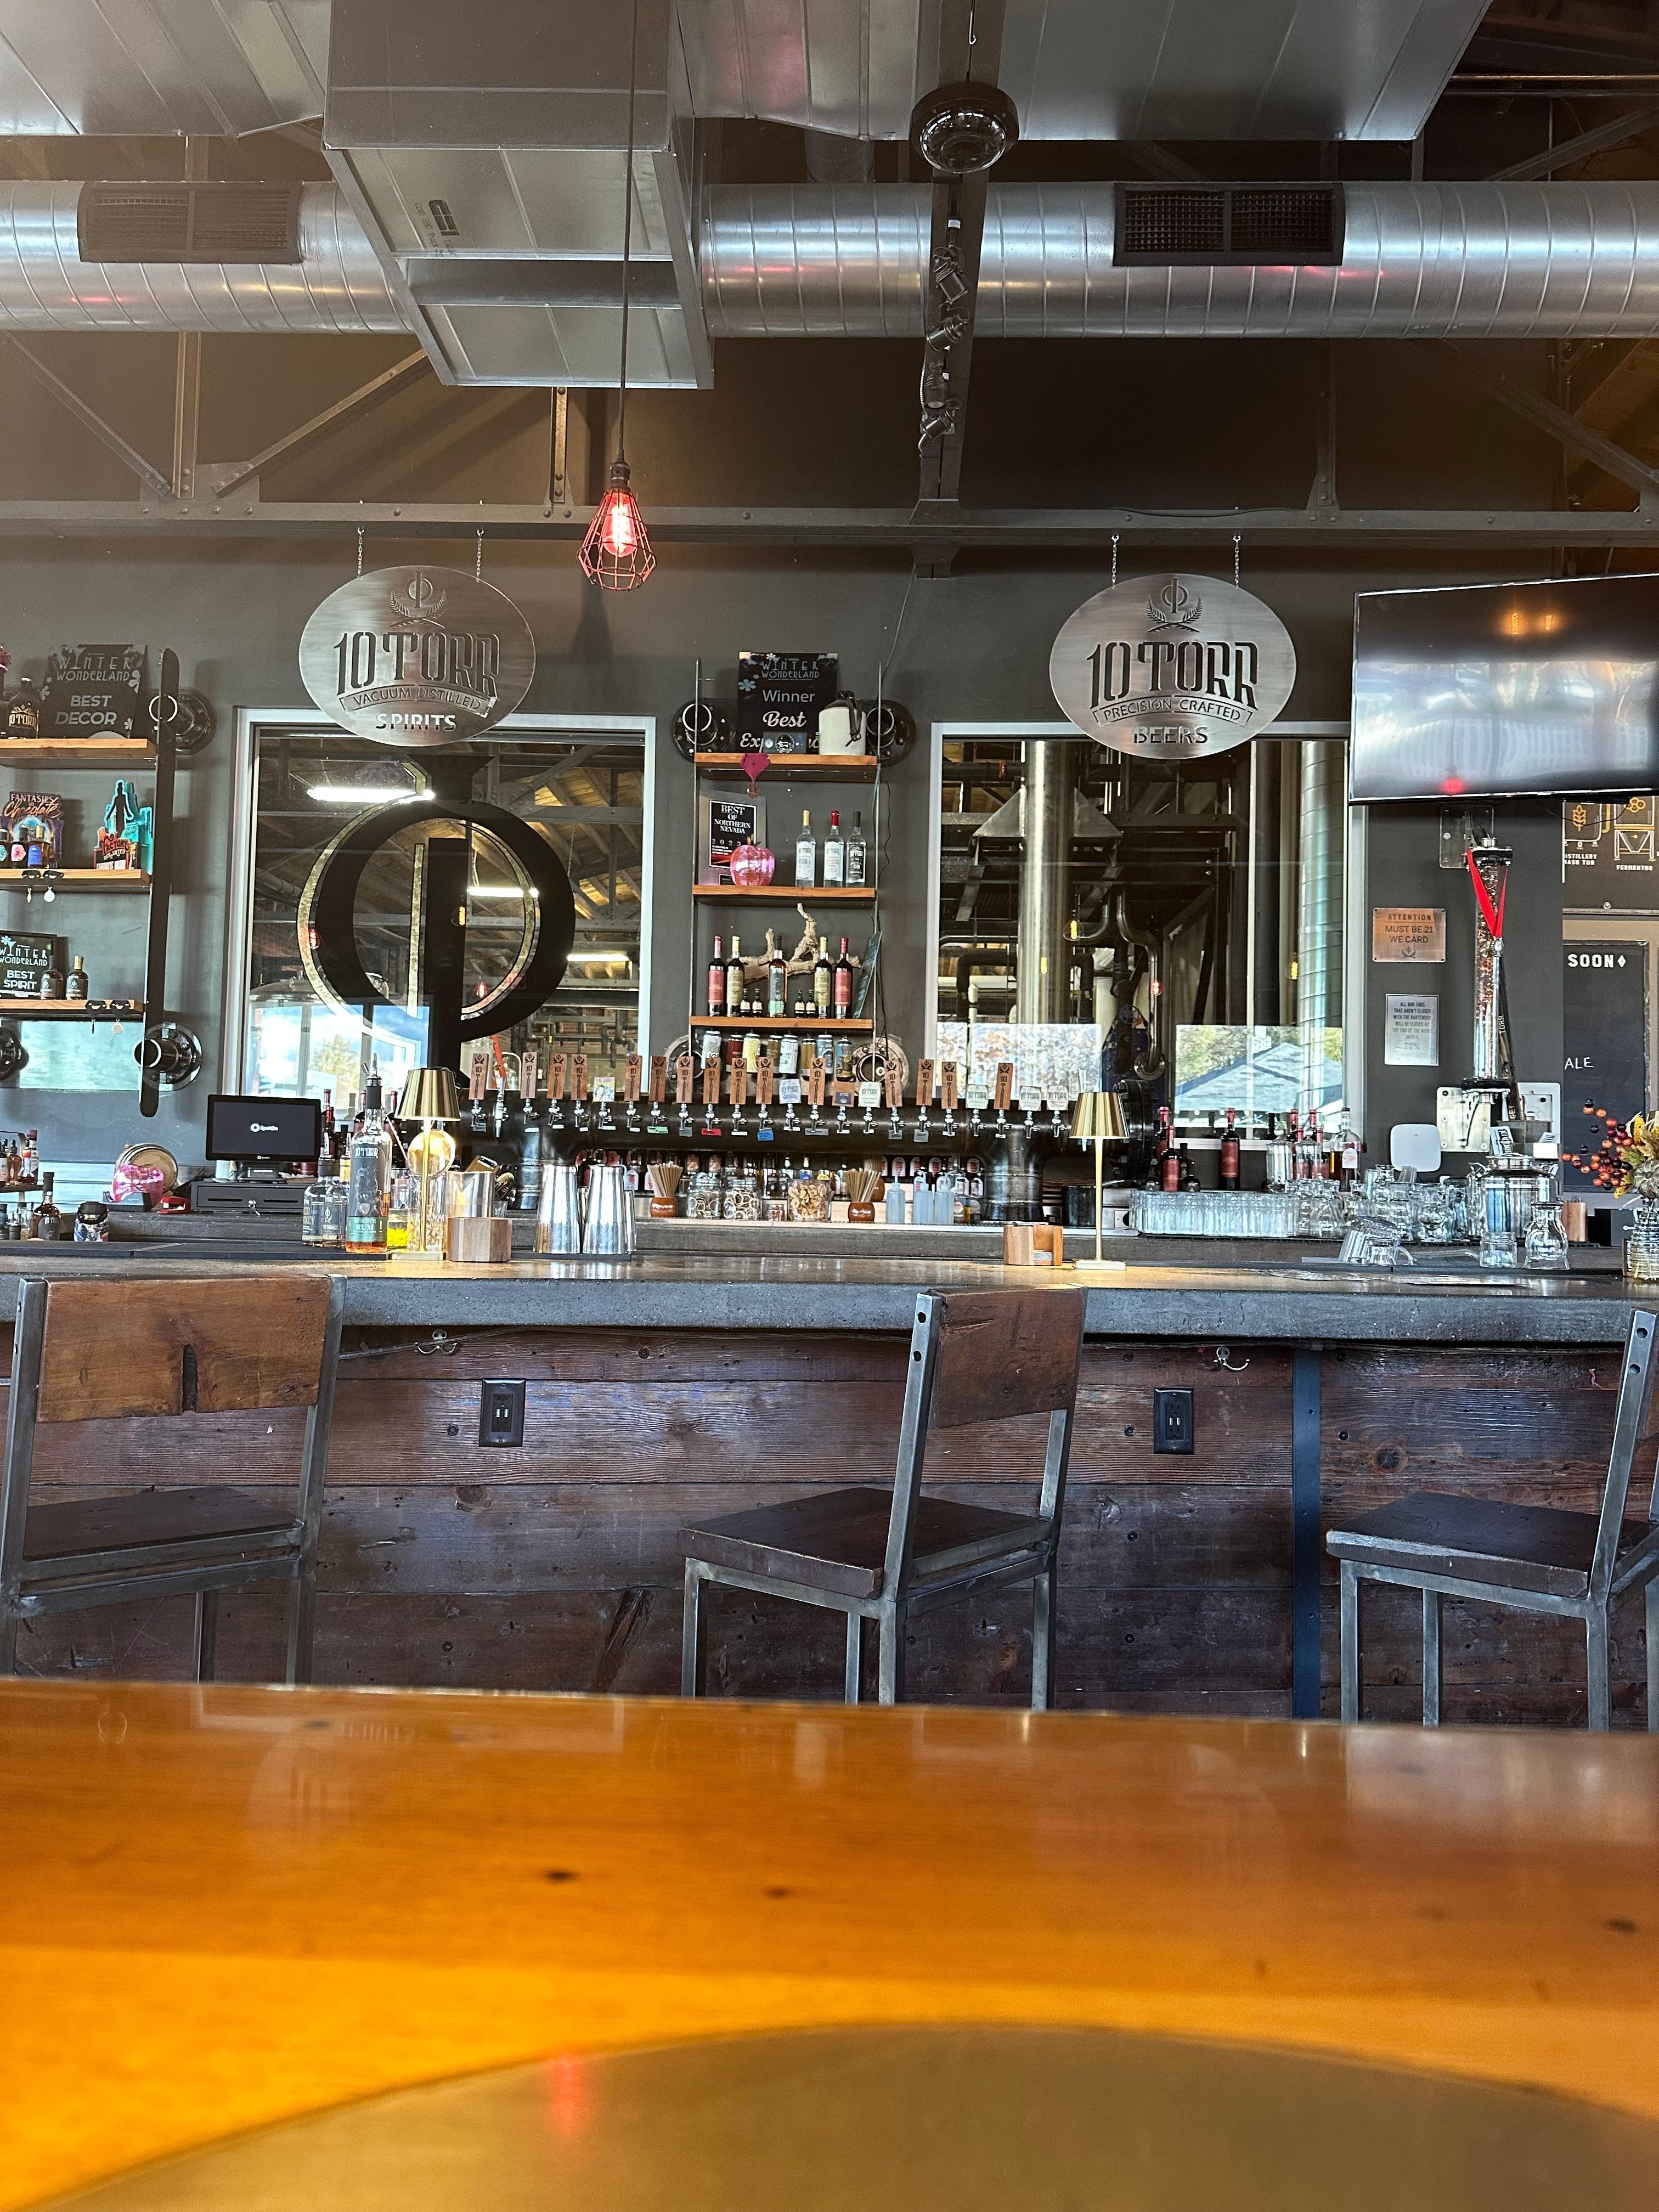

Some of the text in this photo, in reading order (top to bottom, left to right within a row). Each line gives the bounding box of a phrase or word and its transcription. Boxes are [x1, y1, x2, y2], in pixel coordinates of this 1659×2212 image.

[334, 632, 500, 698] 10 TORR
[57, 670, 130, 681] WONDERLAND
[1087, 641, 1258, 711] 10 TORR
[70, 695, 112, 707] BEST
[353, 687, 482, 709] VACUUM DISTILLED
[763, 690, 815, 703] Winner
[1103, 698, 1242, 722] PRECISION CRAFTED
[55, 712, 117, 725] DECOR
[376, 713, 457, 732] SPIRITS
[763, 710, 807, 727] Best
[1133, 727, 1208, 744] BEERS
[721, 805, 745, 816] BEST
[714, 819, 751, 829] NORTHERN
[720, 826, 746, 834] NEVADA
[1568, 954, 1614, 968] SOON
[7, 970, 35, 979] BEST
[3, 980, 37, 990] SPIRIT
[1564, 1057, 1594, 1070] ALE
